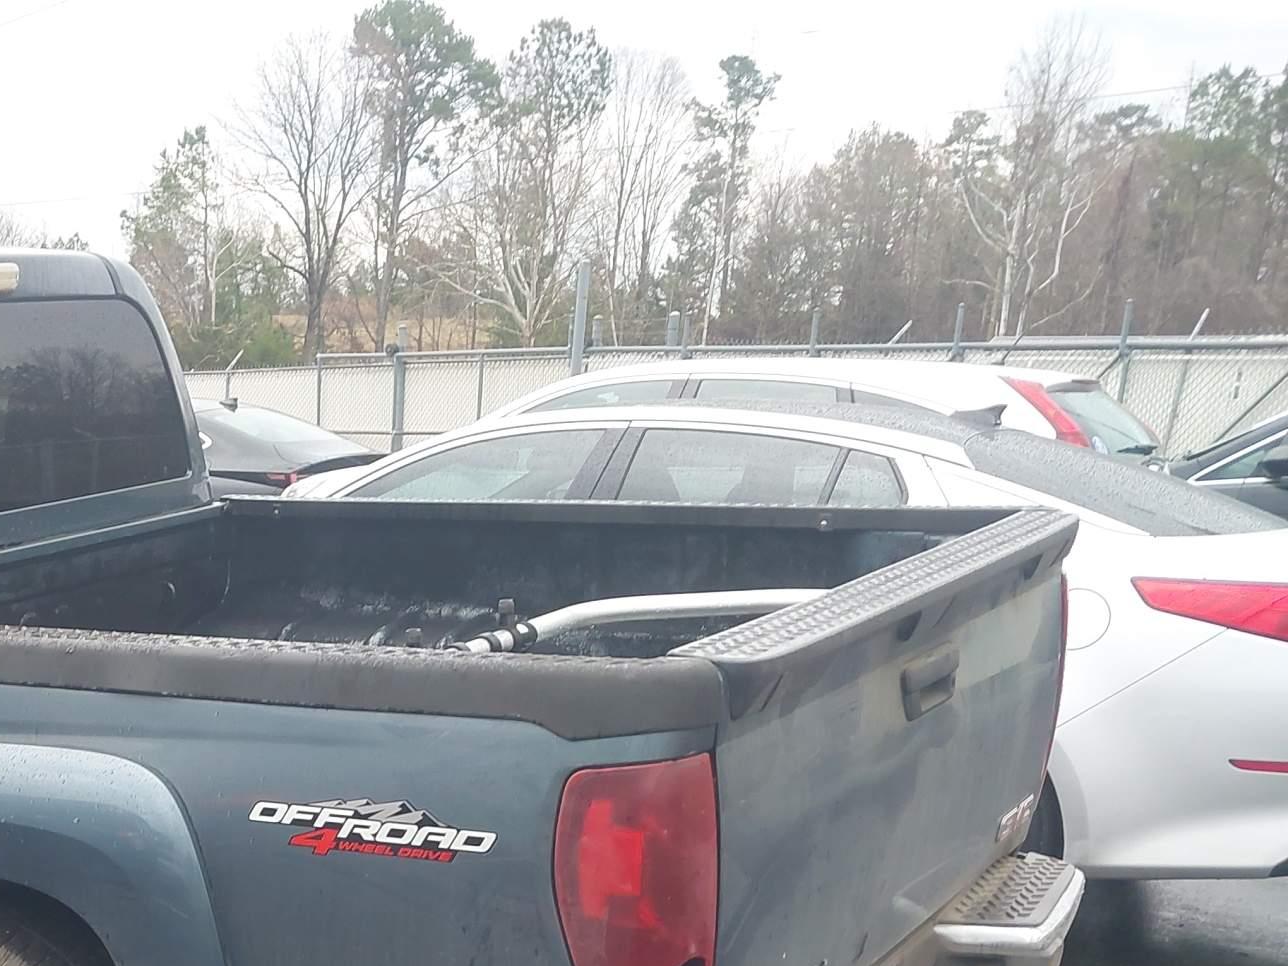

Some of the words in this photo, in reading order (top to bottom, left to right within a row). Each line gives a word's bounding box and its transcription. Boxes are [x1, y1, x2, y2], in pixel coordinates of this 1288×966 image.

[248, 801, 356, 828] OFF
[336, 819, 498, 853] ROAD
[289, 828, 338, 856] 4
[338, 841, 395, 856] WHEEL
[397, 847, 453, 862] DRIVE
